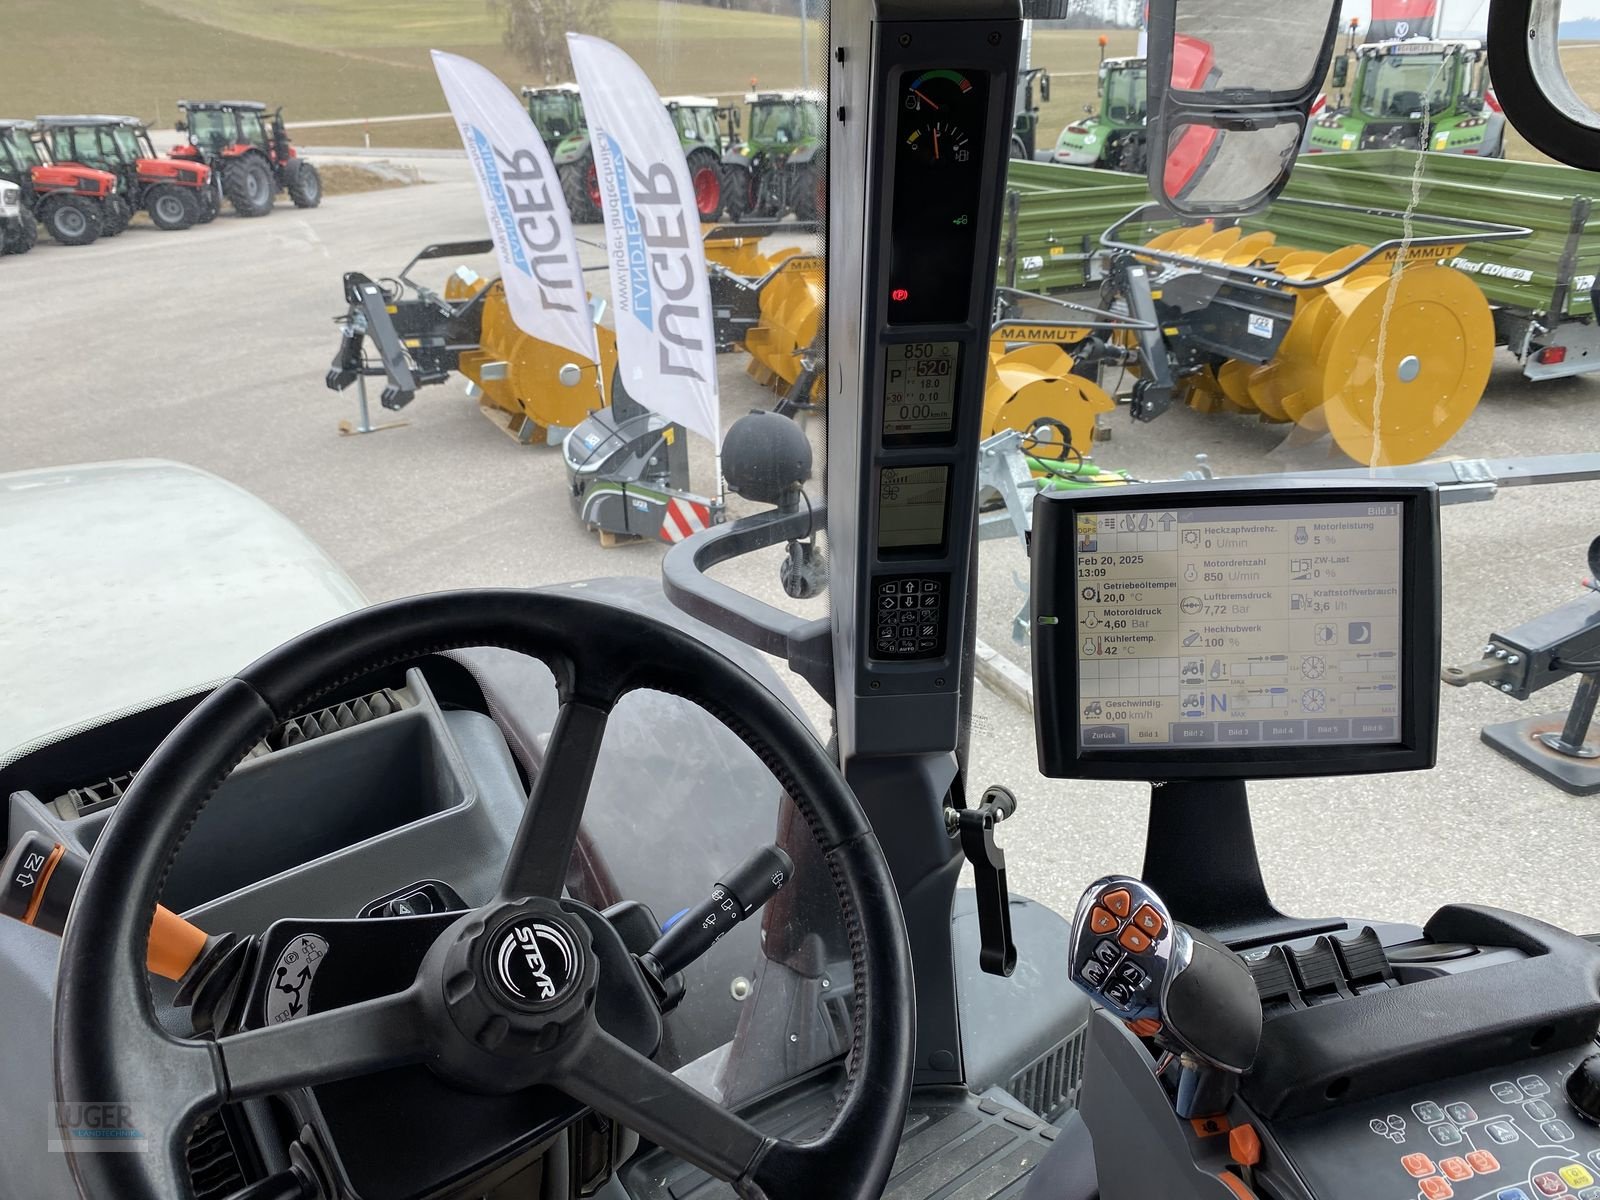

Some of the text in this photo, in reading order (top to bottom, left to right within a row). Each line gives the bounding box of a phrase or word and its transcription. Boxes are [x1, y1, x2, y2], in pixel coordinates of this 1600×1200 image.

[1000, 328, 1078, 341] MAMMUT
[904, 343, 933, 359] 850
[890, 369, 902, 383] P
[1367, 507, 1387, 516] Bild
[1204, 525, 1278, 536] Heckzapfwdrehz.
[1313, 522, 1375, 532] Motorleistung
[1204, 539, 1248, 549] 0 U/min
[1314, 535, 1336, 545] 5 %
[1078, 555, 1144, 567] Feb 20, 2025
[1203, 558, 1267, 568] Motordrehzahl
[1313, 556, 1350, 564] ZW-Last
[1078, 568, 1106, 578] 13:09
[1203, 571, 1260, 582] 850 U/min
[1313, 569, 1336, 578] 0 %
[1203, 591, 1272, 601] Luftbremsdruck
[1313, 587, 1398, 597] Kraftstoffverbrauch
[1103, 592, 1143, 604] 20,0 °C
[1103, 607, 1162, 617] Motoröldruck
[1203, 604, 1251, 616] 7,72 Bar
[1313, 602, 1330, 612] 3,6
[1103, 619, 1149, 631] 4,60 Bar
[1203, 624, 1262, 634] Heckhubwerk
[1103, 635, 1156, 644] Kühlertemp.
[1203, 638, 1240, 648] 100 %
[1104, 646, 1136, 656] 42 °C
[1210, 693, 1227, 712] N
[1105, 710, 1153, 721] 0,00 km/h
[1091, 731, 1117, 739] Zurück
[1138, 730, 1153, 738] Bild
[513, 926, 557, 1001] STEYR
